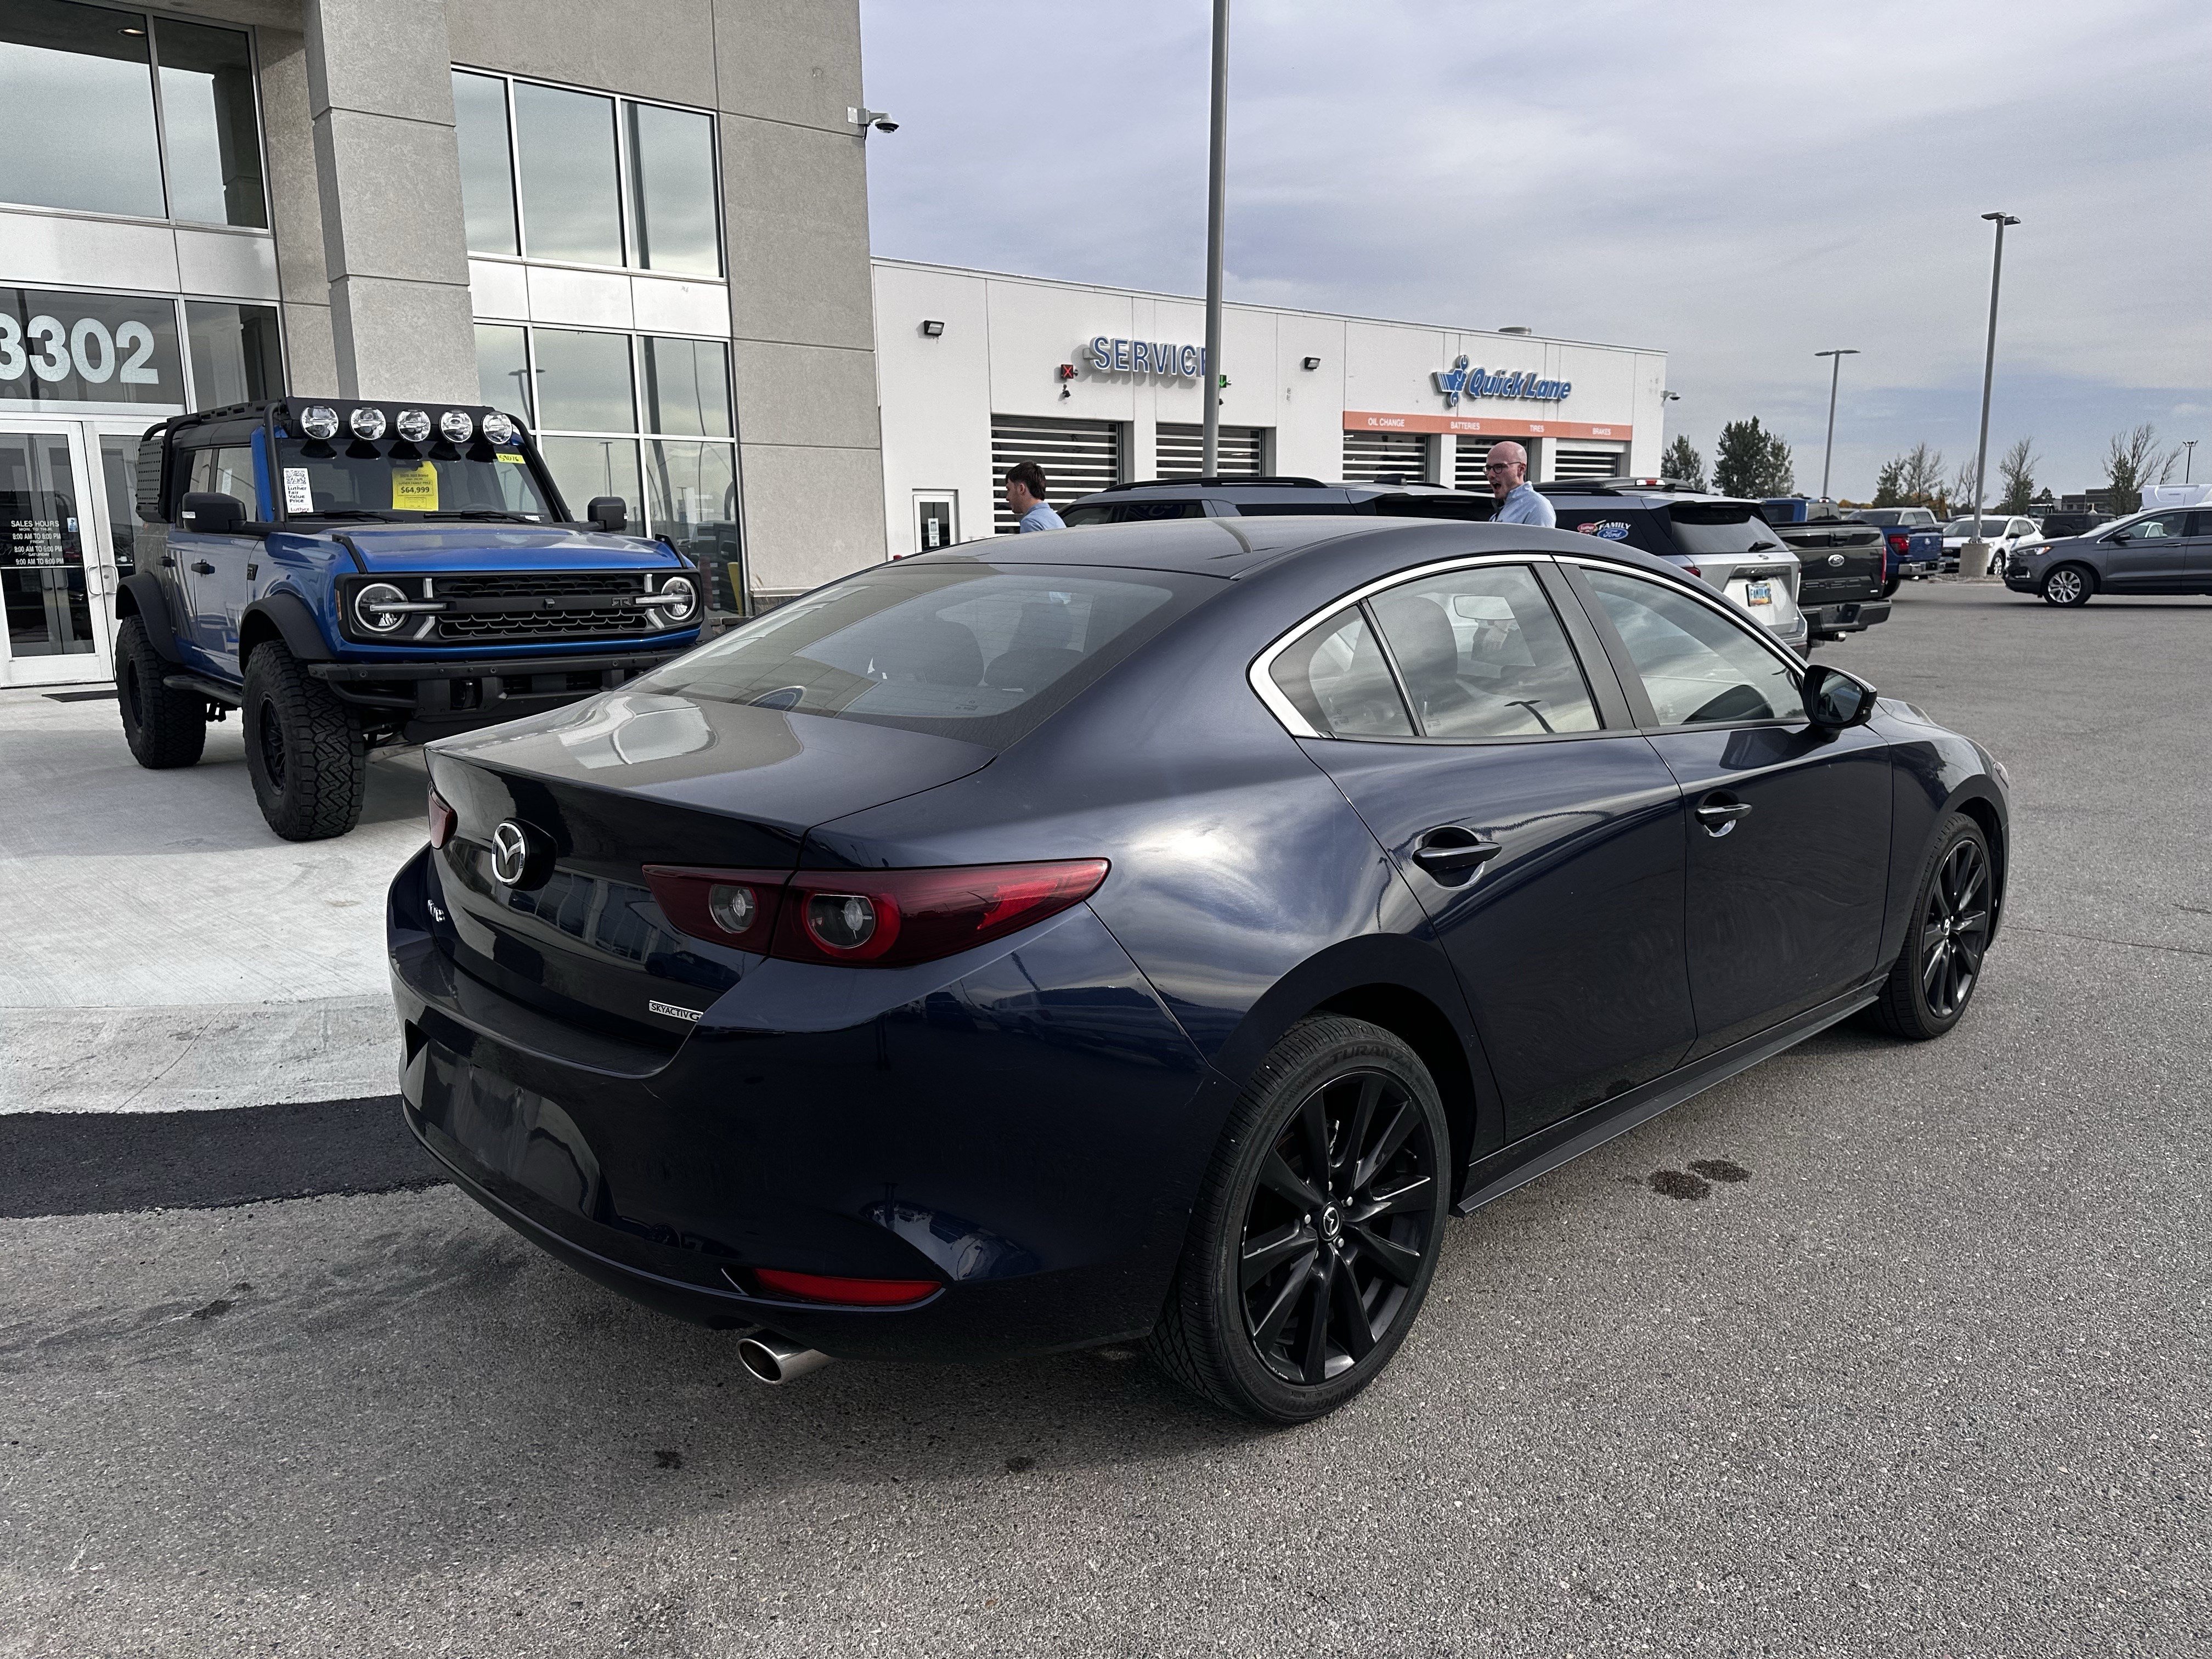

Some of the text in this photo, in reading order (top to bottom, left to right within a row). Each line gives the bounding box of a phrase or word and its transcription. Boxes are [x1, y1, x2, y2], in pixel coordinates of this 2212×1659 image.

[0, 313, 159, 385] 3302
[1368, 417, 1406, 427] OIL CHANGE
[1450, 421, 1480, 431] BATTERIES
[1529, 424, 1545, 433] TIRES
[1592, 427, 1611, 436] BRAKES
[1599, 522, 1631, 531] FAMILY
